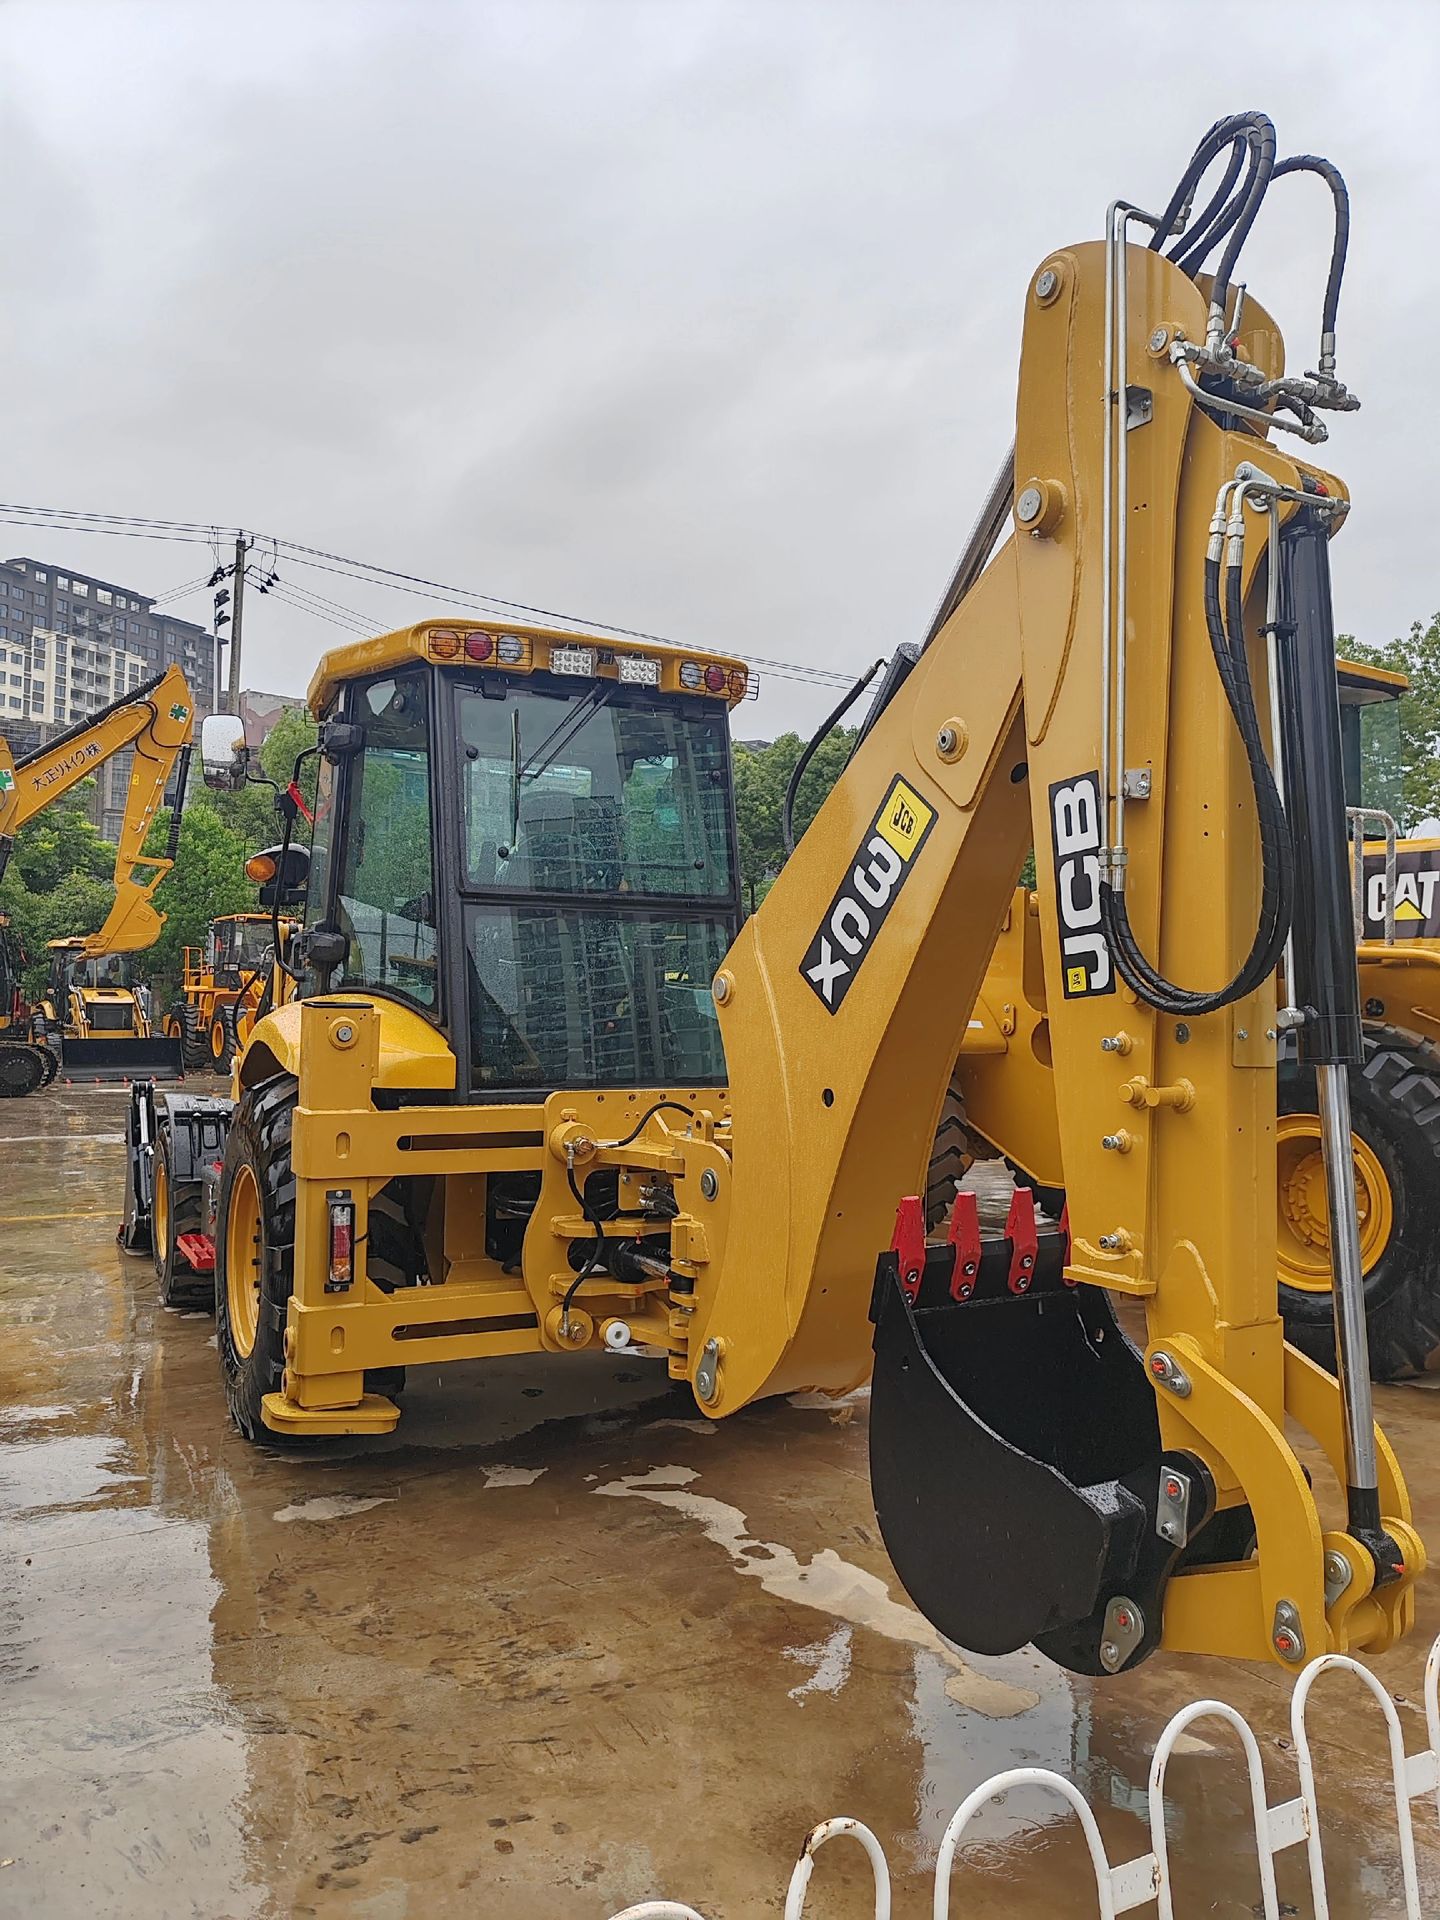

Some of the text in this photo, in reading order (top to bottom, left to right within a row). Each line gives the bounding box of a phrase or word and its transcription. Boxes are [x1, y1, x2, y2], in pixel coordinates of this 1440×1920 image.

[893, 801, 914, 834] JCB
[1054, 779, 1110, 990] JCB
[1368, 871, 1440, 921] CAT
